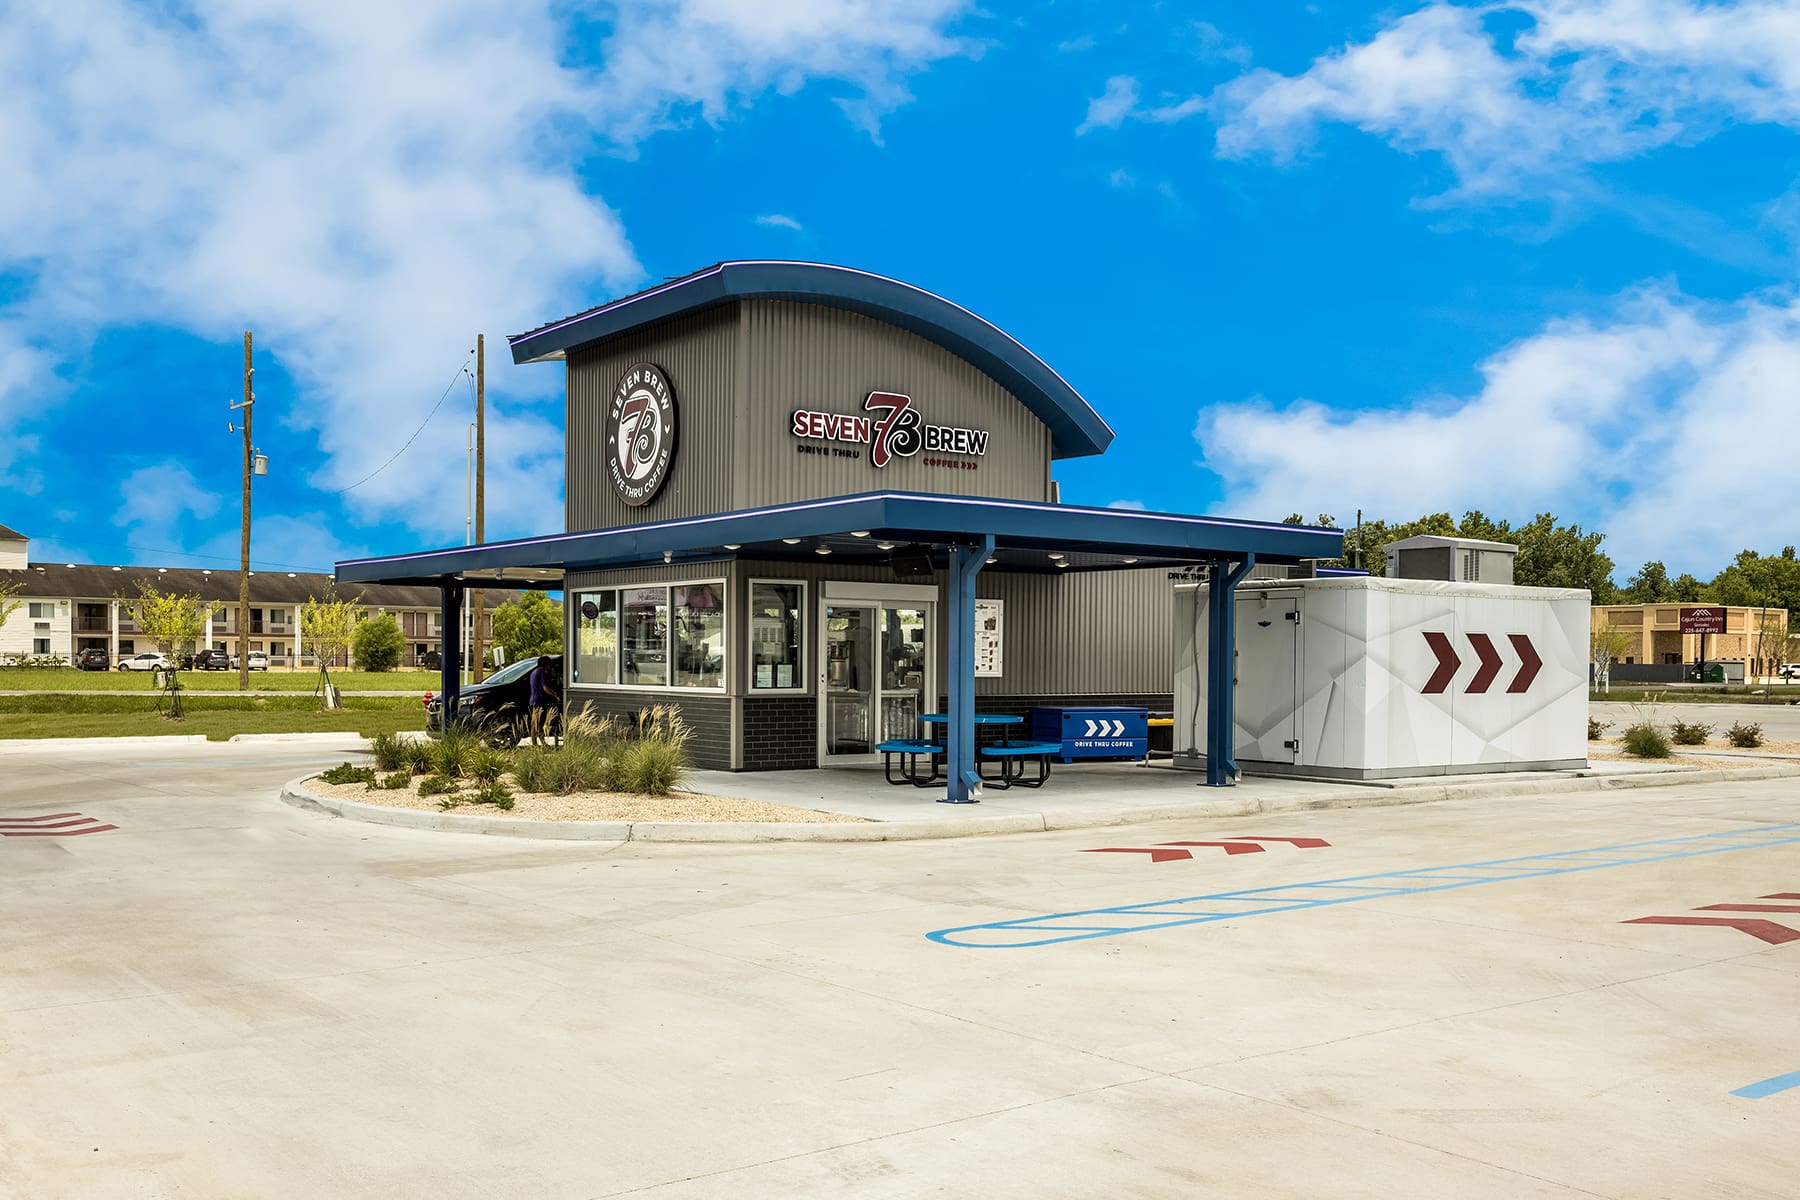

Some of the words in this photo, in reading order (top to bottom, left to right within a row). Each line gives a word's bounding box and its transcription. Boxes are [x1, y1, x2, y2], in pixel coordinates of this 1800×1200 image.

[612, 370, 640, 420] SEVEN
[644, 370, 670, 410] BREW
[793, 410, 870, 443] SEVEN
[925, 425, 989, 455] BREW
[798, 445, 829, 456] DRIVE
[832, 448, 860, 459] THRU
[923, 457, 959, 469] COFFEE
[610, 457, 625, 491] DRIVE
[625, 485, 643, 498] THRU
[644, 448, 668, 493] COFFEE
[1168, 572, 1189, 580] DRIVE
